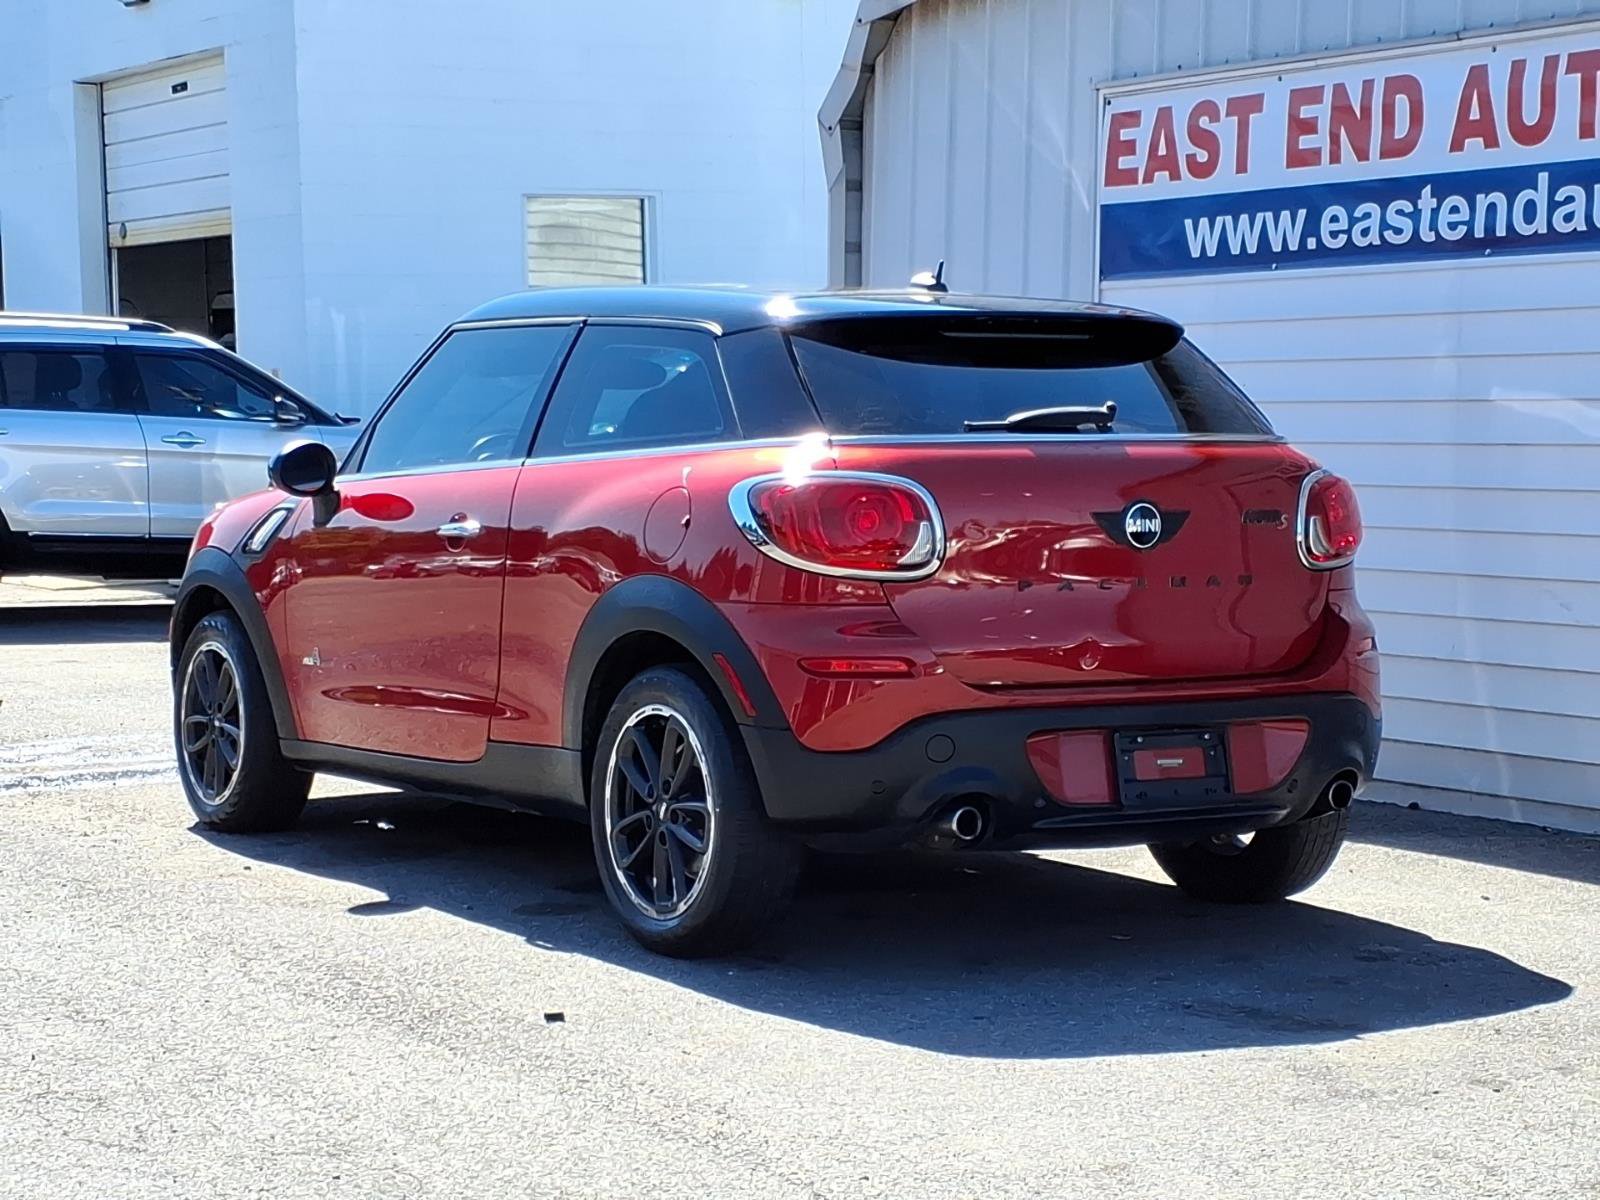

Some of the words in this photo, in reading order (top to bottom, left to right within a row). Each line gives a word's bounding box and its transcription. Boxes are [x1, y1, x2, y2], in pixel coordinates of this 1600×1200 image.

[1103, 92, 1265, 188] EAST
[1285, 73, 1425, 170] END
[1448, 49, 1600, 154] AUT
[1184, 171, 1600, 259] www.eastenda
[1128, 518, 1160, 533] MINI
